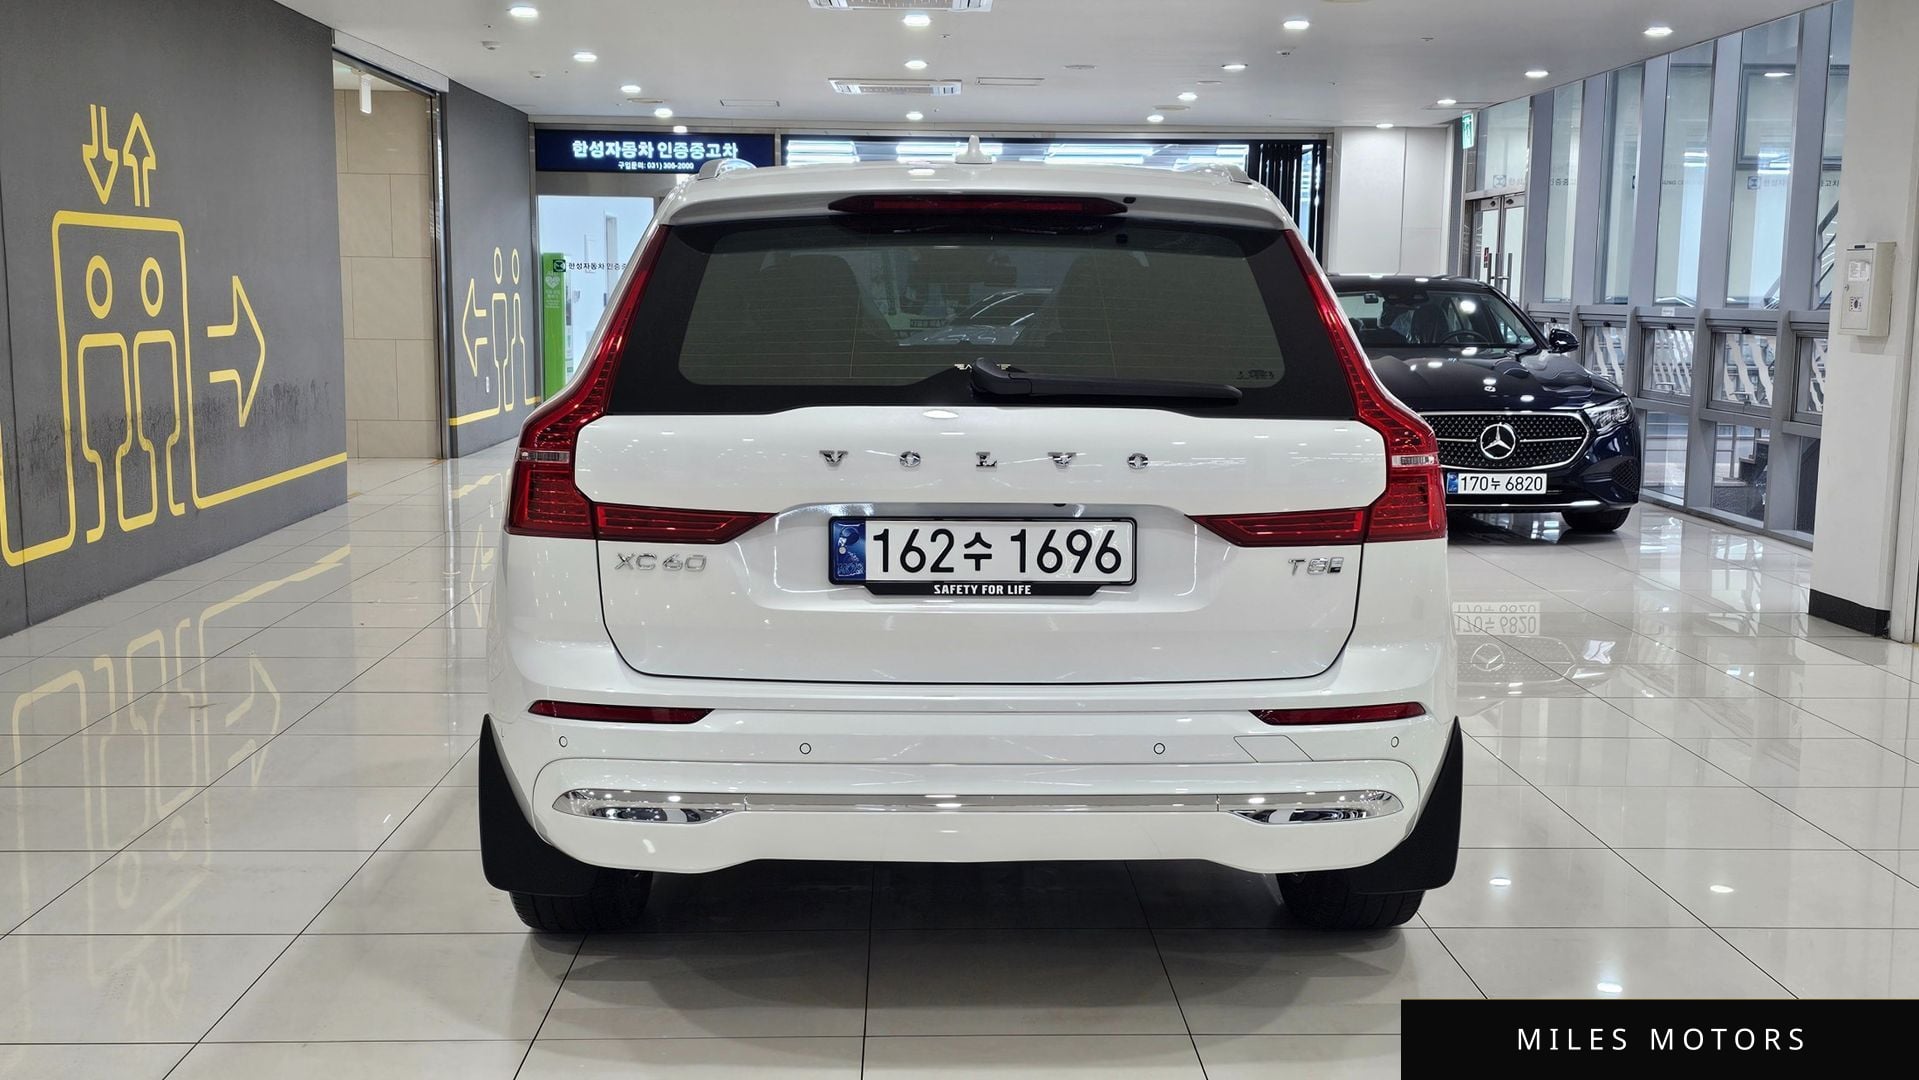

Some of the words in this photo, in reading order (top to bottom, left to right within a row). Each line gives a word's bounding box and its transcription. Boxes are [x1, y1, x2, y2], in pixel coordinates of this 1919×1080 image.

[572, 140, 654, 158] 한성자동차
[658, 142, 738, 160] 인증중고차
[819, 450, 1149, 467] VOLVO
[1460, 476, 1501, 491] 170누
[1505, 476, 1543, 491] 6820
[873, 528, 992, 573] 162수
[1010, 528, 1122, 573] 1696
[934, 583, 978, 595] SAFETY
[981, 583, 1004, 595] FOR
[1007, 583, 1032, 595] LIFE
